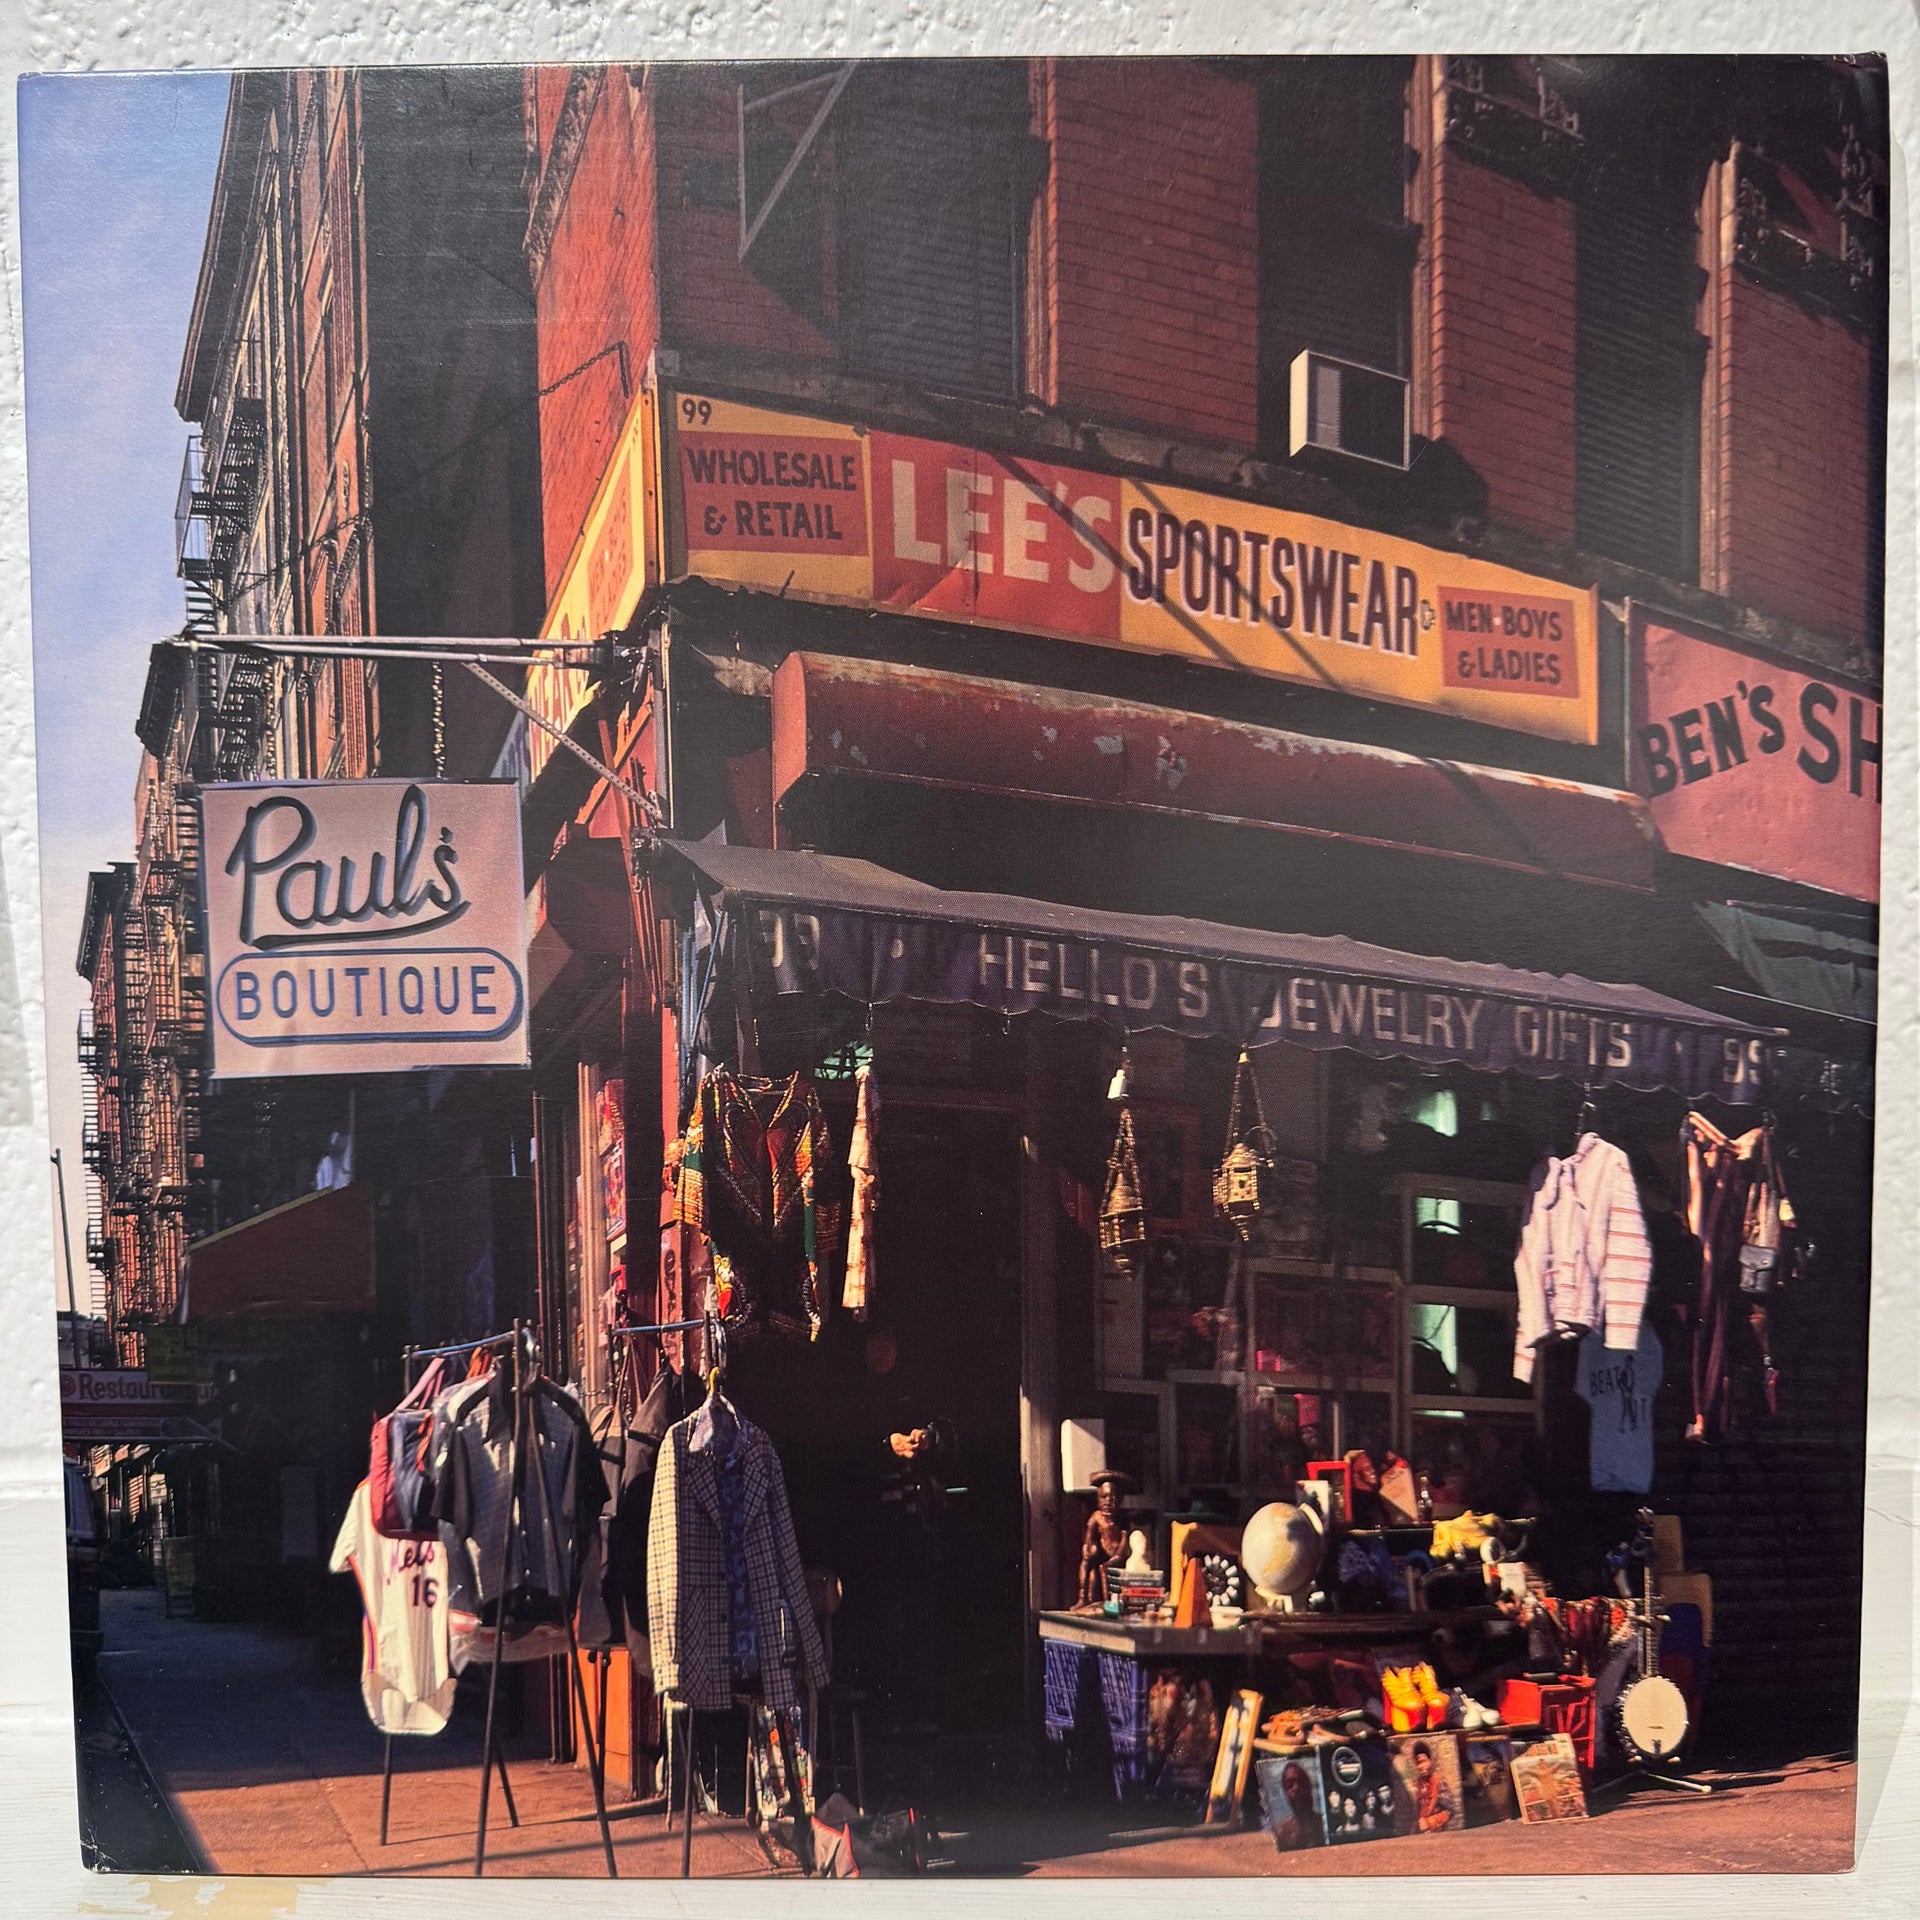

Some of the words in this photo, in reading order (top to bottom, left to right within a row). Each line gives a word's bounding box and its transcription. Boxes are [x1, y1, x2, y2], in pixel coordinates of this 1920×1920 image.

[682, 400, 712, 425] 99
[687, 449, 856, 491] WHOLESALE
[703, 504, 727, 537] &
[736, 500, 843, 540] RETAIL
[891, 459, 1113, 594] LEE'S
[1125, 507, 1419, 659] SPORTSWEAR
[1638, 680, 1785, 798] BEN'S
[1797, 682, 1883, 804] SH
[225, 784, 471, 950] Paul's
[236, 965, 497, 1022] BOUTIQUE
[1514, 1004, 1632, 1068] GIFTS
[393, 1540, 434, 1573] ets
[412, 1574, 440, 1608] 16
